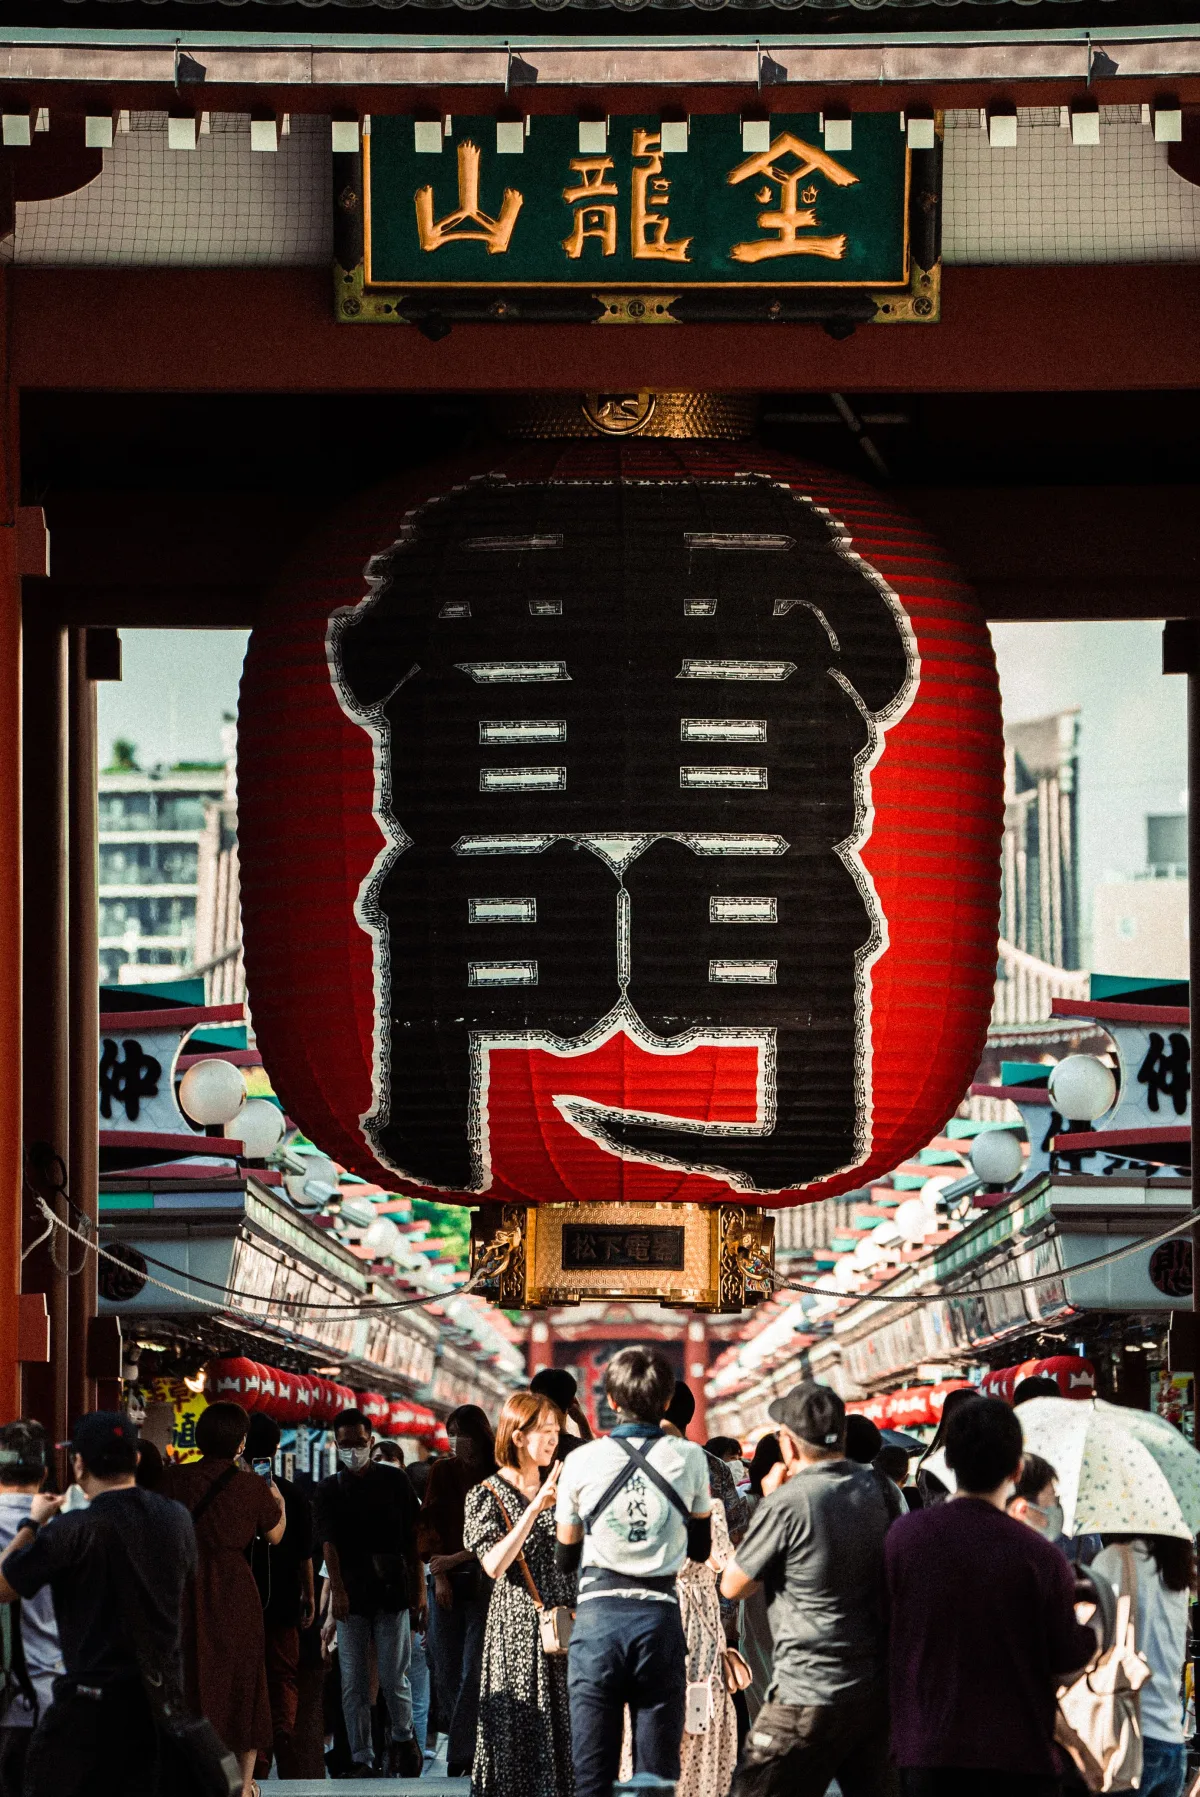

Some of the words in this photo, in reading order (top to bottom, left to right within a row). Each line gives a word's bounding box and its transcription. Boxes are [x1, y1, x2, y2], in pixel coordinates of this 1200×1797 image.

[325, 471, 922, 1195] 雷門
[571, 1232, 678, 1262] 松下電器
[626, 1474, 648, 1542] 時代屋
